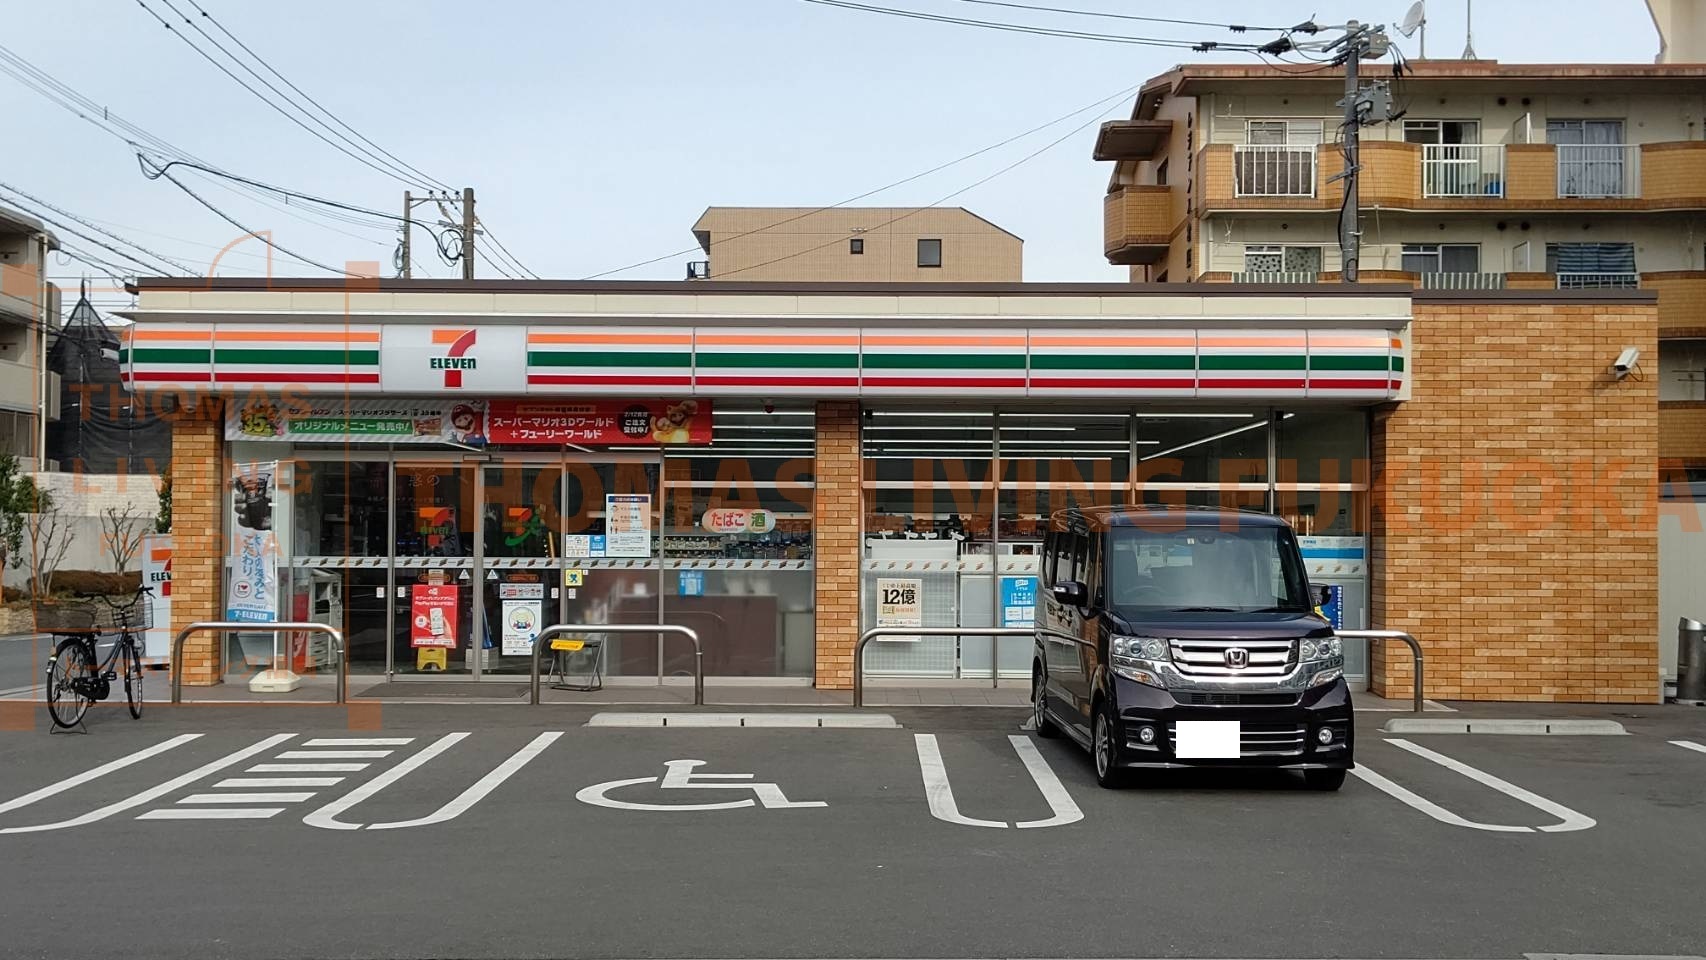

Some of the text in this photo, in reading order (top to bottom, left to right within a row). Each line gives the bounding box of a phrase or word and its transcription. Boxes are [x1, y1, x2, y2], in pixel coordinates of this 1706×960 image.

[432, 329, 476, 387] 7
[494, 417, 614, 427] スーパーマリオ3Dワールド
[711, 512, 766, 527] たばこ 酒
[151, 572, 172, 581] ELEV
[882, 588, 917, 605] 12億
